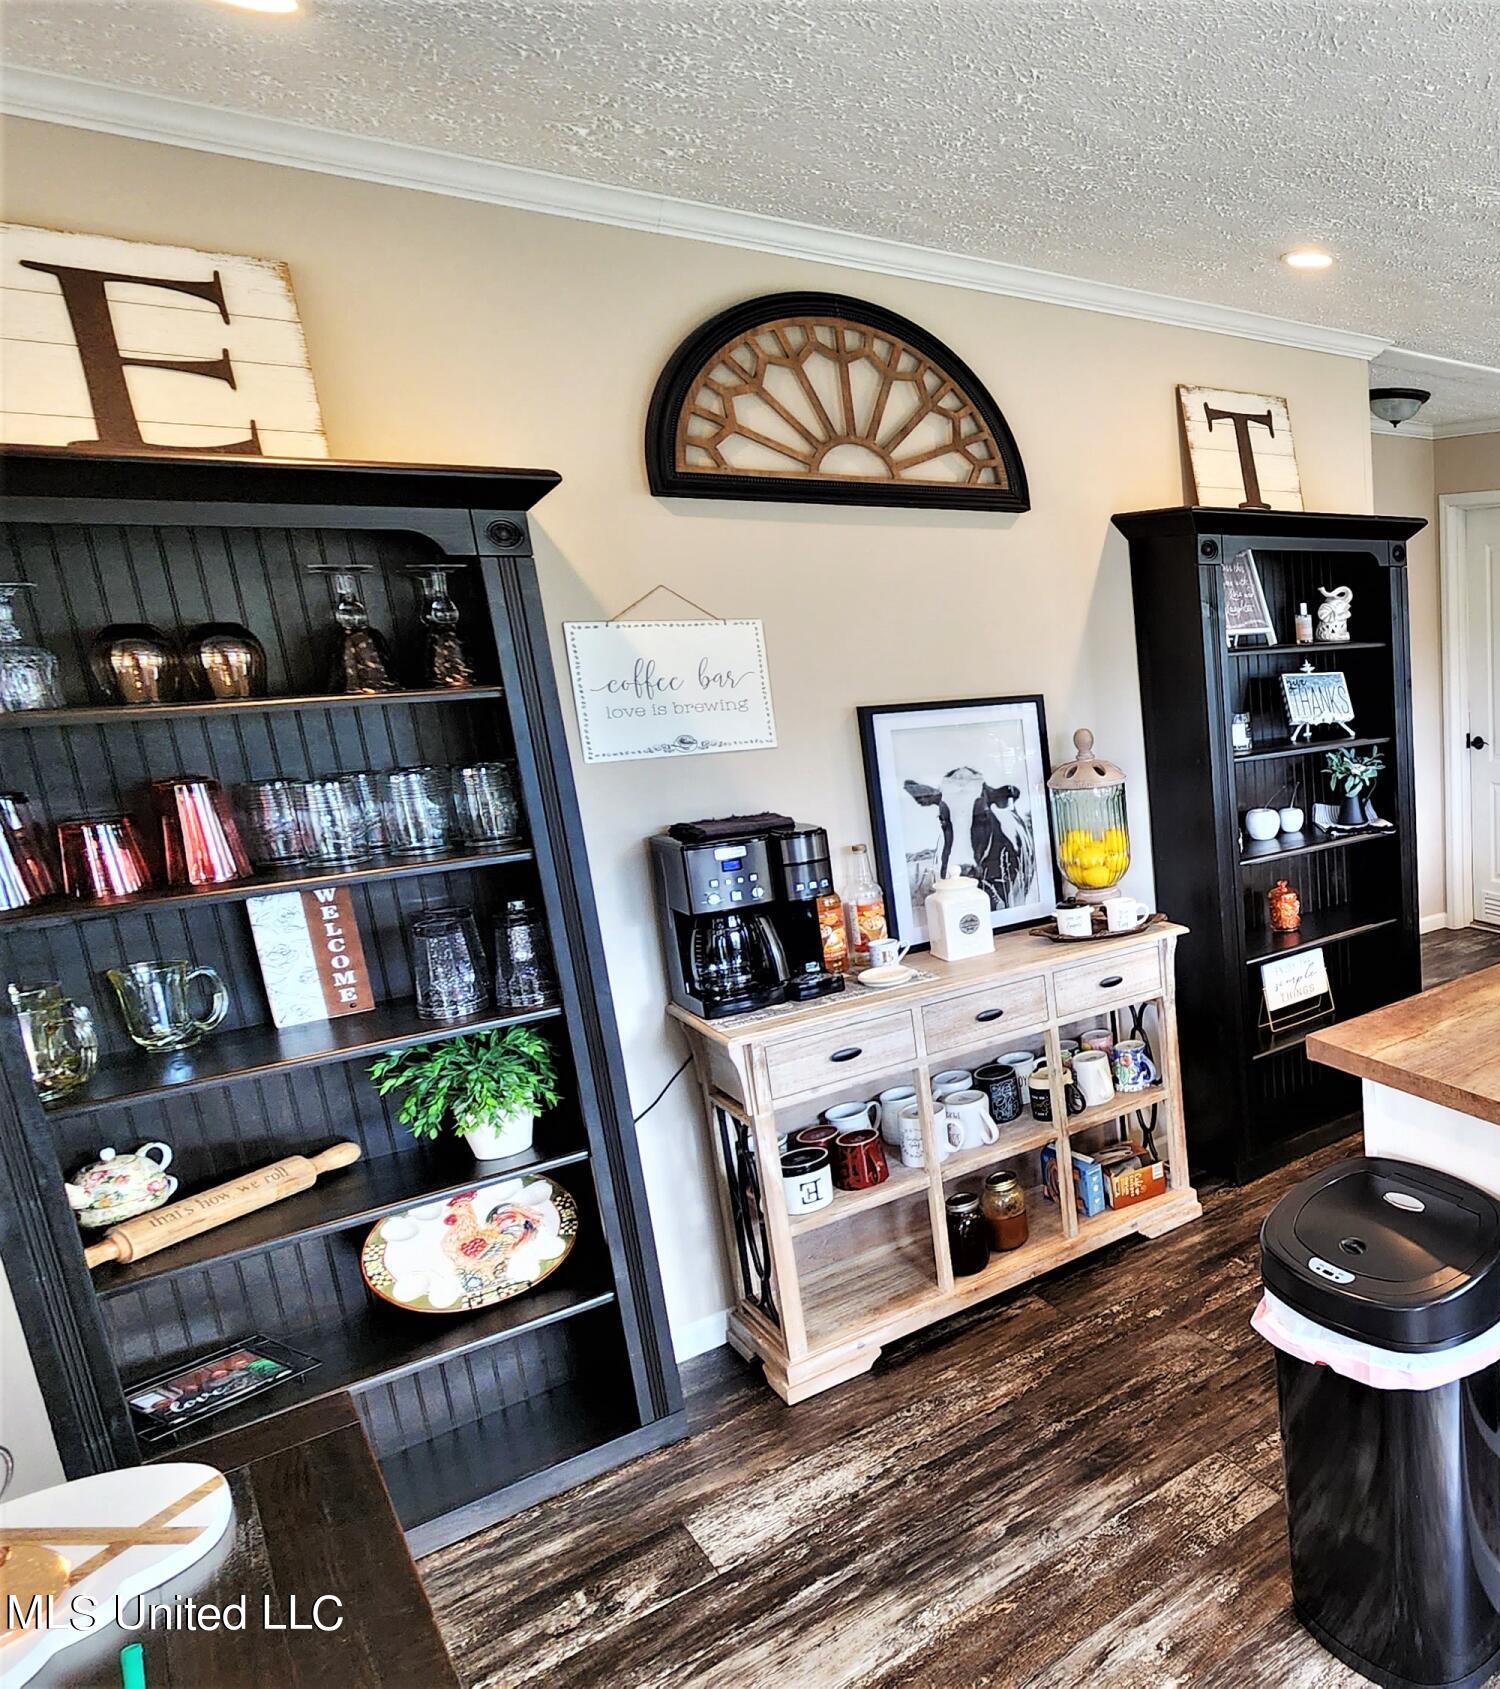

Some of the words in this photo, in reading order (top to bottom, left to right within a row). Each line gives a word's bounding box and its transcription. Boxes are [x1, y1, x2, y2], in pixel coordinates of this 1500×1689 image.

[19, 259, 263, 456] E
[1203, 402, 1275, 510] T
[590, 657, 685, 700] coffee
[698, 656, 755, 690] bar
[606, 704, 646, 720] love
[652, 703, 668, 717] is
[672, 698, 749, 715] brewing
[1290, 685, 1350, 717] THANKS
[313, 887, 359, 1003] WELCOME
[1280, 983, 1316, 1002] THINGS
[195, 1191, 231, 1210] how
[237, 1181, 260, 1193] we
[264, 1165, 290, 1185] roll
